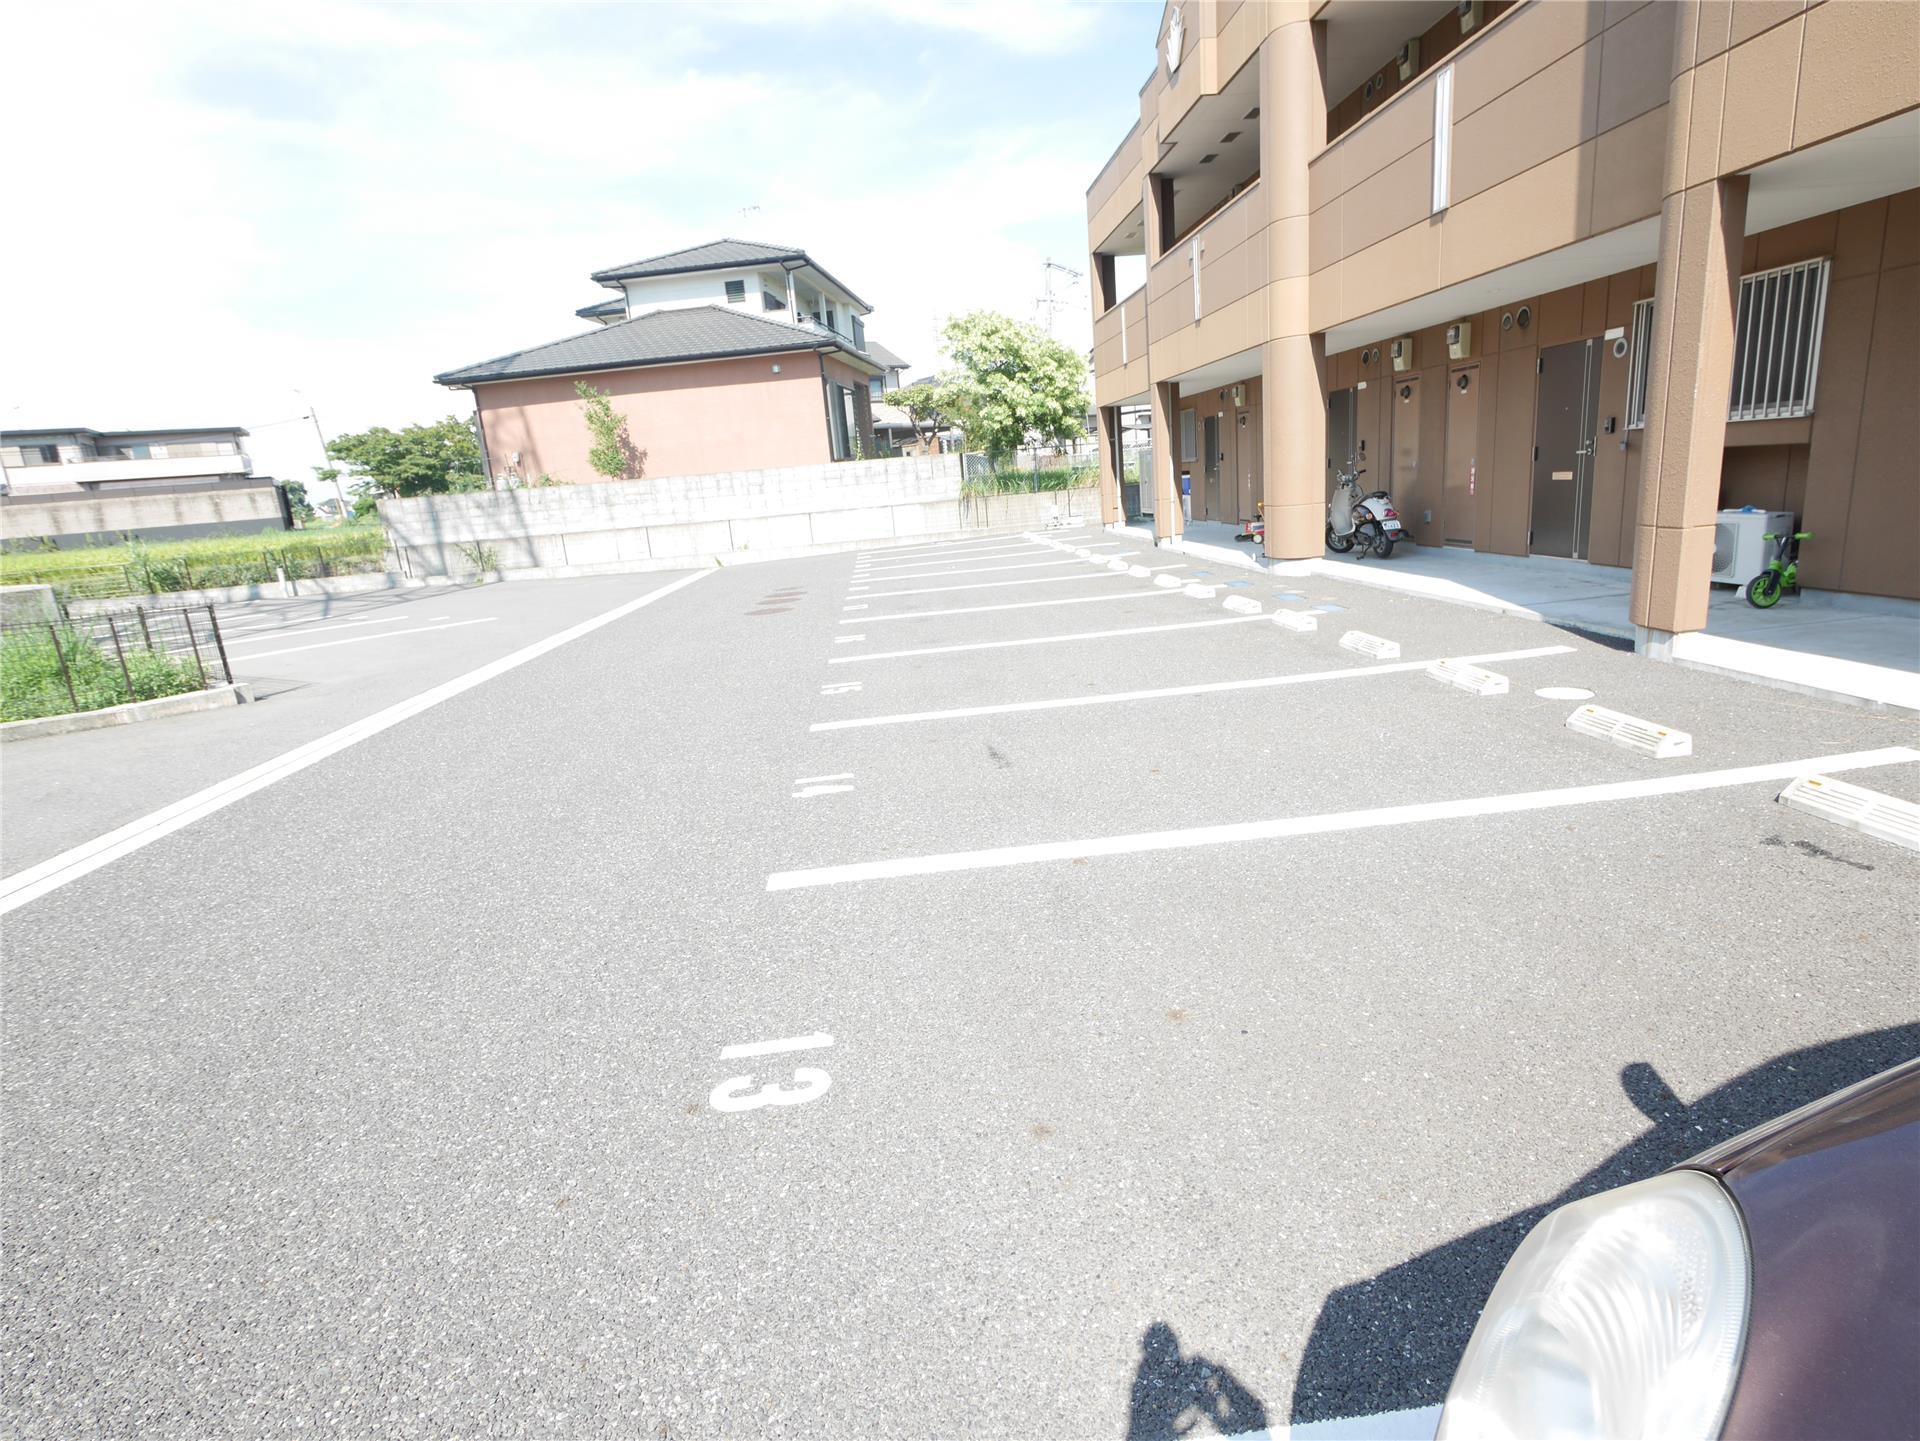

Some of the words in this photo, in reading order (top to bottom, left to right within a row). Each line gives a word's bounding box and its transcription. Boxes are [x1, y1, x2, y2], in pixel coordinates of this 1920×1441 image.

[820, 681, 863, 695] 15
[791, 772, 855, 798] 14
[708, 1030, 835, 1113] 13
